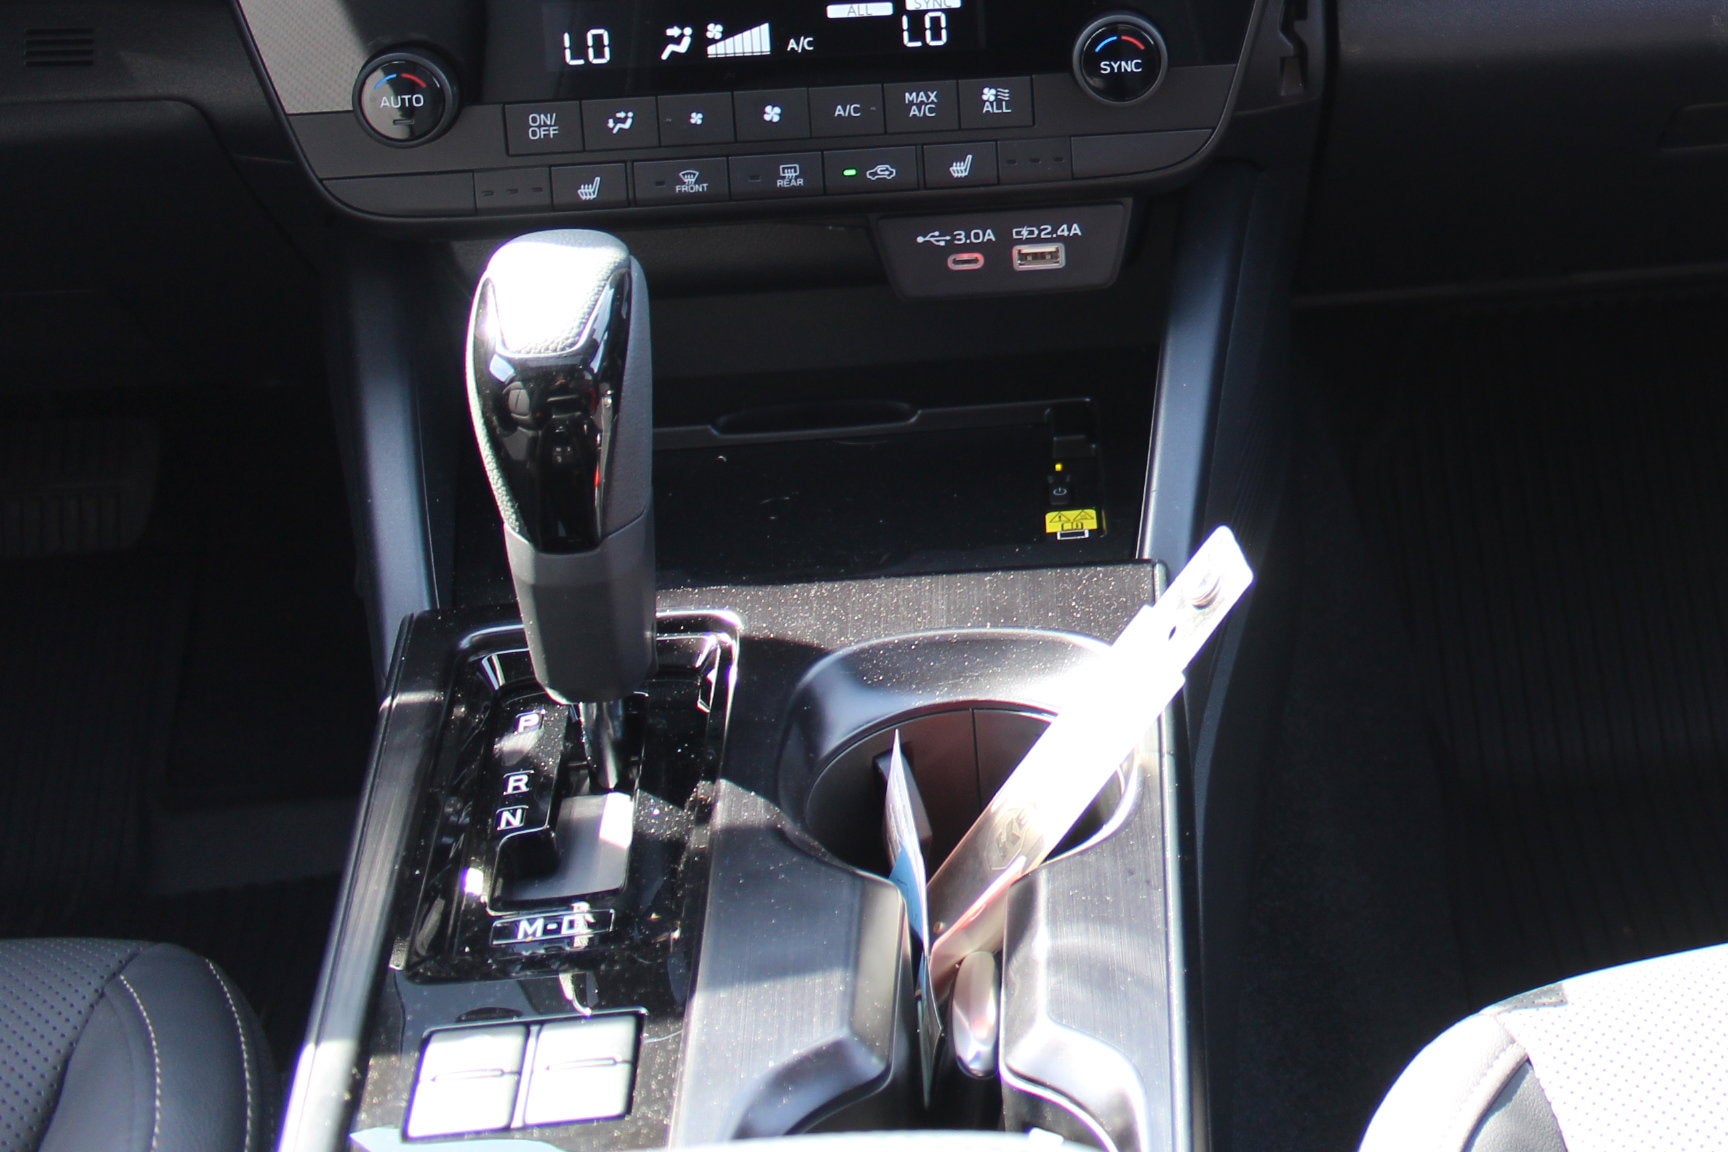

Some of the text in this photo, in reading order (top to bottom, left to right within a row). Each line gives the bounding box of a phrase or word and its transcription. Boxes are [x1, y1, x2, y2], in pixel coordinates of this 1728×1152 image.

[847, 5, 873, 17] ALL
[902, 11, 947, 47] LO
[563, 28, 611, 65] LO
[787, 36, 814, 53] A/C
[1100, 59, 1142, 74] SYNC
[380, 94, 424, 109] AUTO
[905, 91, 938, 104] MAX
[834, 104, 861, 117] A/C
[909, 104, 936, 118] A/C
[983, 102, 1012, 114] ALL
[529, 112, 556, 127] ON/
[529, 126, 559, 140] OFF
[676, 183, 708, 194] FRONT
[777, 179, 804, 188] REAR
[953, 229, 996, 244] 3.0A
[1040, 223, 1082, 239] 2.4A
[518, 713, 540, 732] P
[506, 774, 529, 793] R
[501, 808, 523, 828] N
